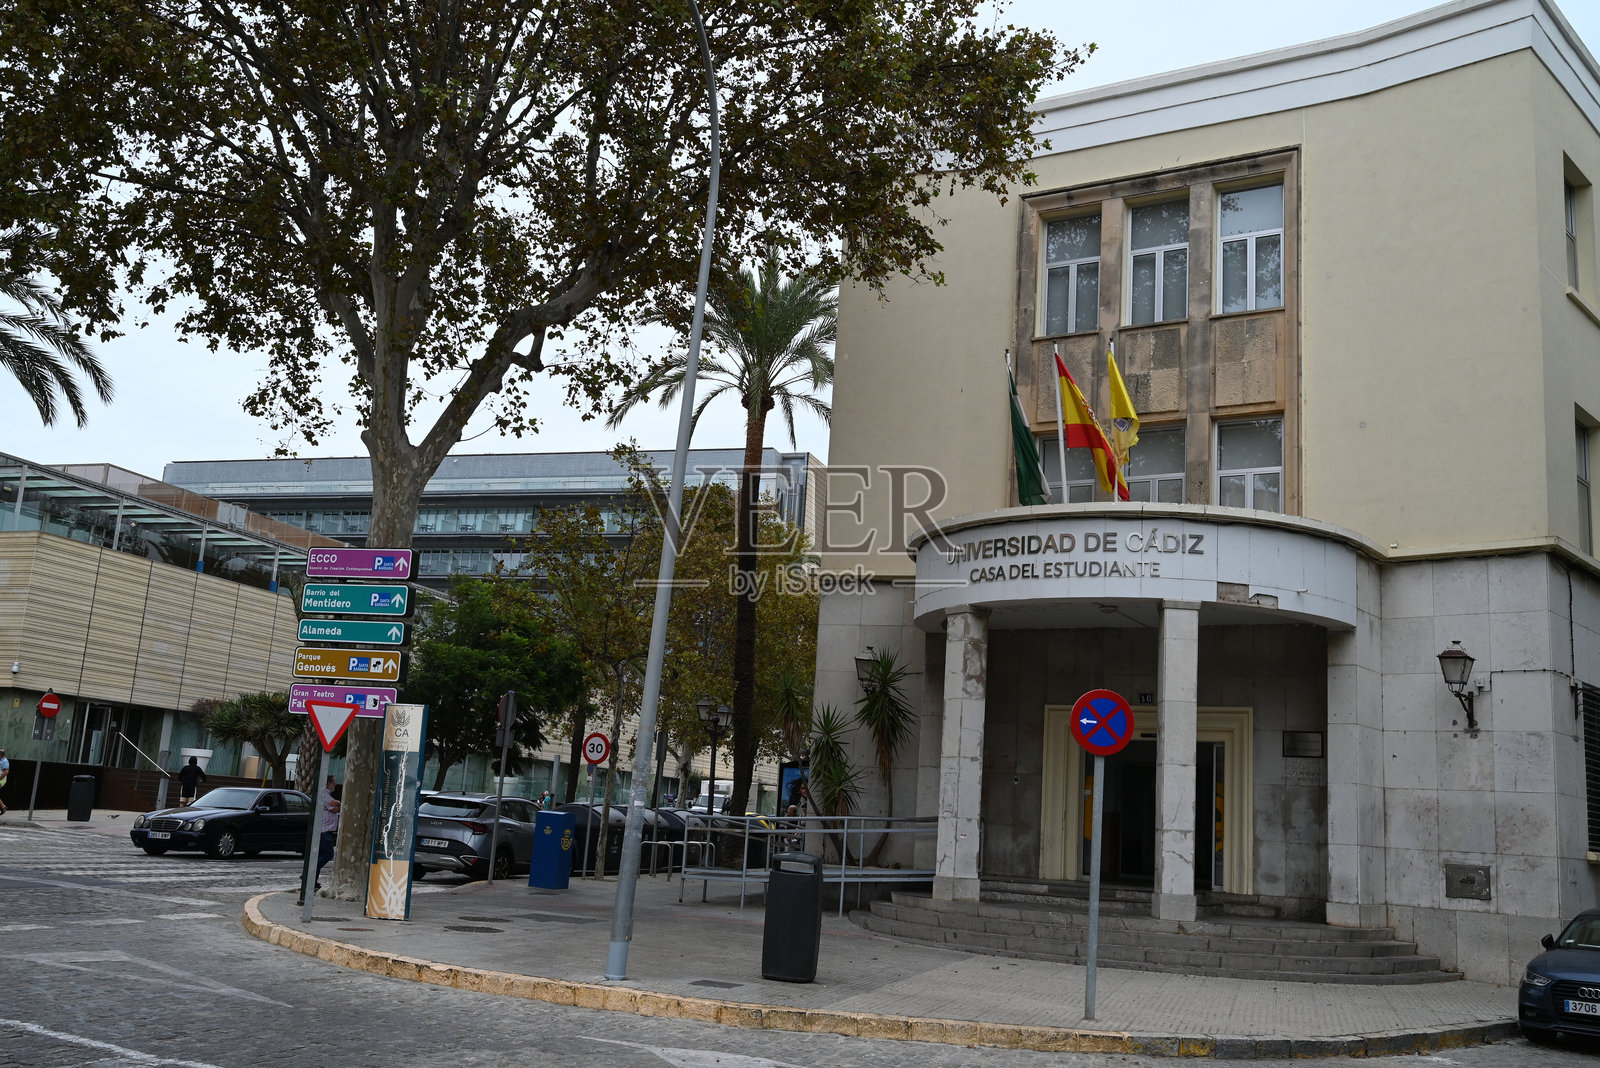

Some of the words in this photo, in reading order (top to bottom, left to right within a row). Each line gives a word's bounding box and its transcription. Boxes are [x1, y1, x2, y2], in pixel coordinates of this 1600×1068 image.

[946, 533, 1076, 565] UNIVERSIDAD
[1084, 532, 1118, 552] DE
[1125, 528, 1204, 555] CÁDIZ
[310, 554, 338, 563] ECCO
[970, 565, 1006, 583] CASA
[1009, 563, 1040, 580] DEL
[1043, 561, 1160, 578] ESTUDIANTE
[304, 598, 351, 608] Mentidero
[301, 625, 342, 635] Alameda
[298, 653, 321, 661] Parque
[296, 661, 337, 673] Genovés
[293, 689, 309, 697] Gran
[313, 690, 335, 698] Teatro
[291, 699, 306, 708] Fal
[588, 743, 603, 754] 30
[1571, 1002, 1598, 1014] 3706
